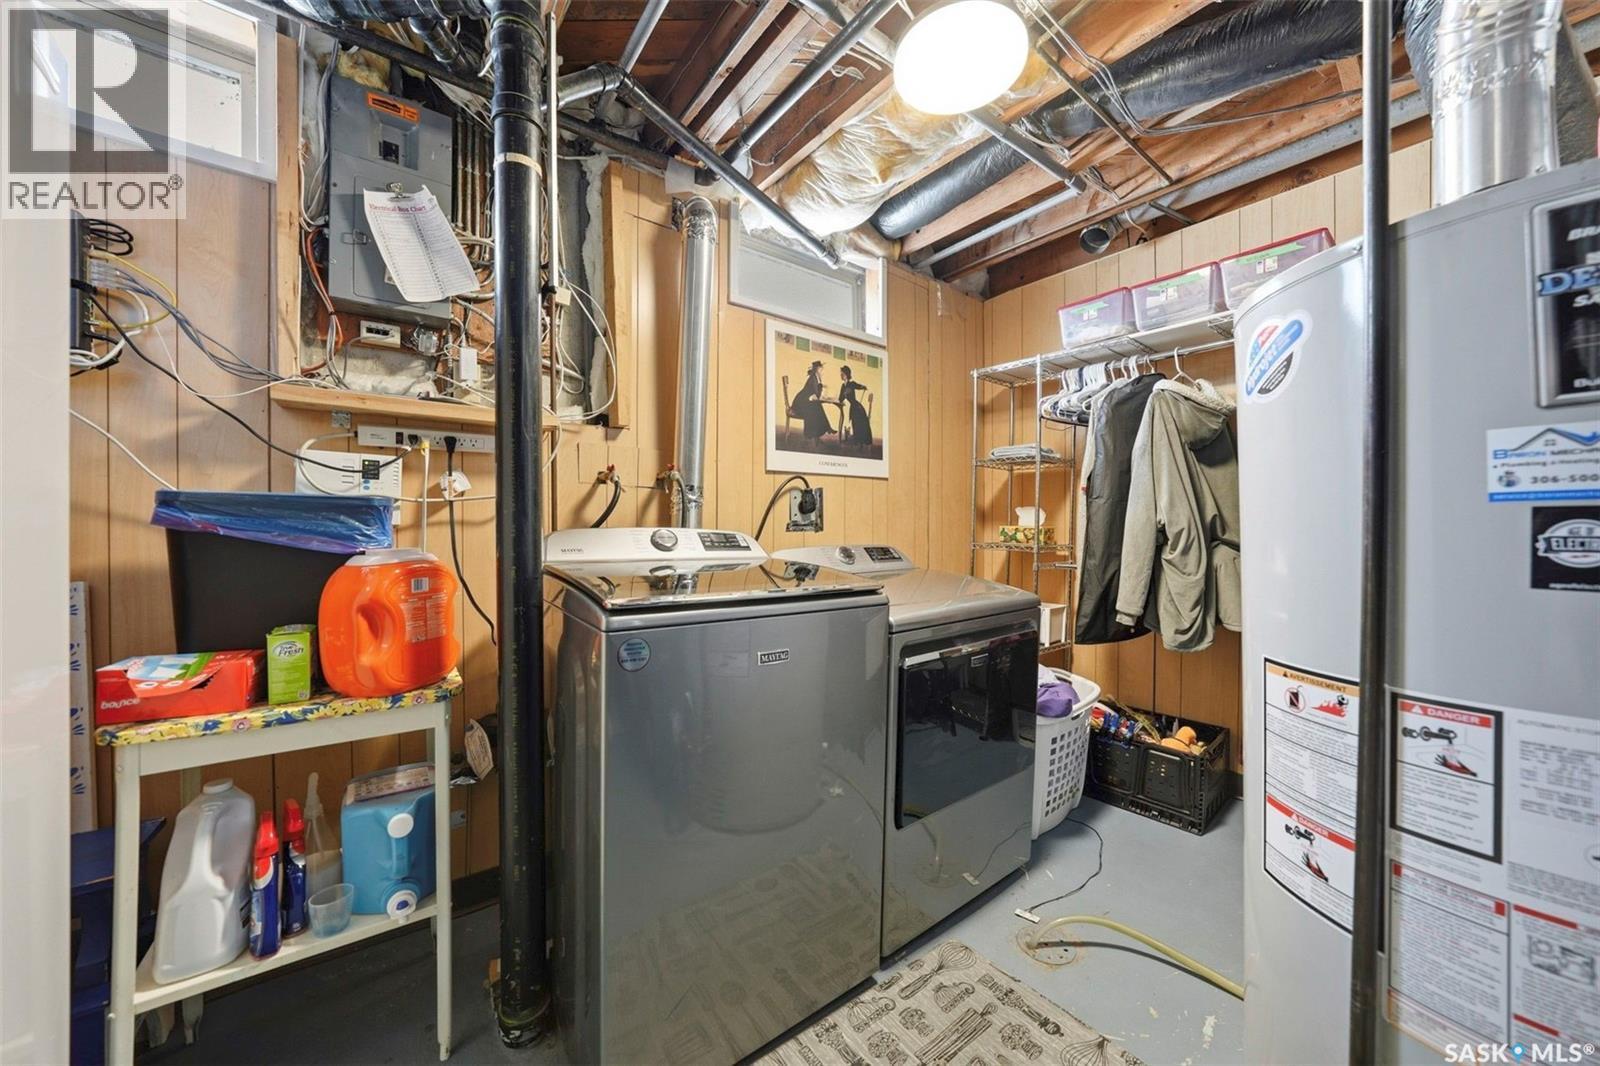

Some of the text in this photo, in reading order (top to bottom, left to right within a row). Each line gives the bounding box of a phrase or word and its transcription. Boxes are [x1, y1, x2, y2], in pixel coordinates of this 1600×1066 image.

[278, 647, 304, 657] Fresh
[761, 651, 789, 663] MAYTAG
[1289, 671, 1348, 693] AVERTISSEMENT
[100, 698, 141, 710] bounce
[1426, 707, 1482, 726] DANGER
